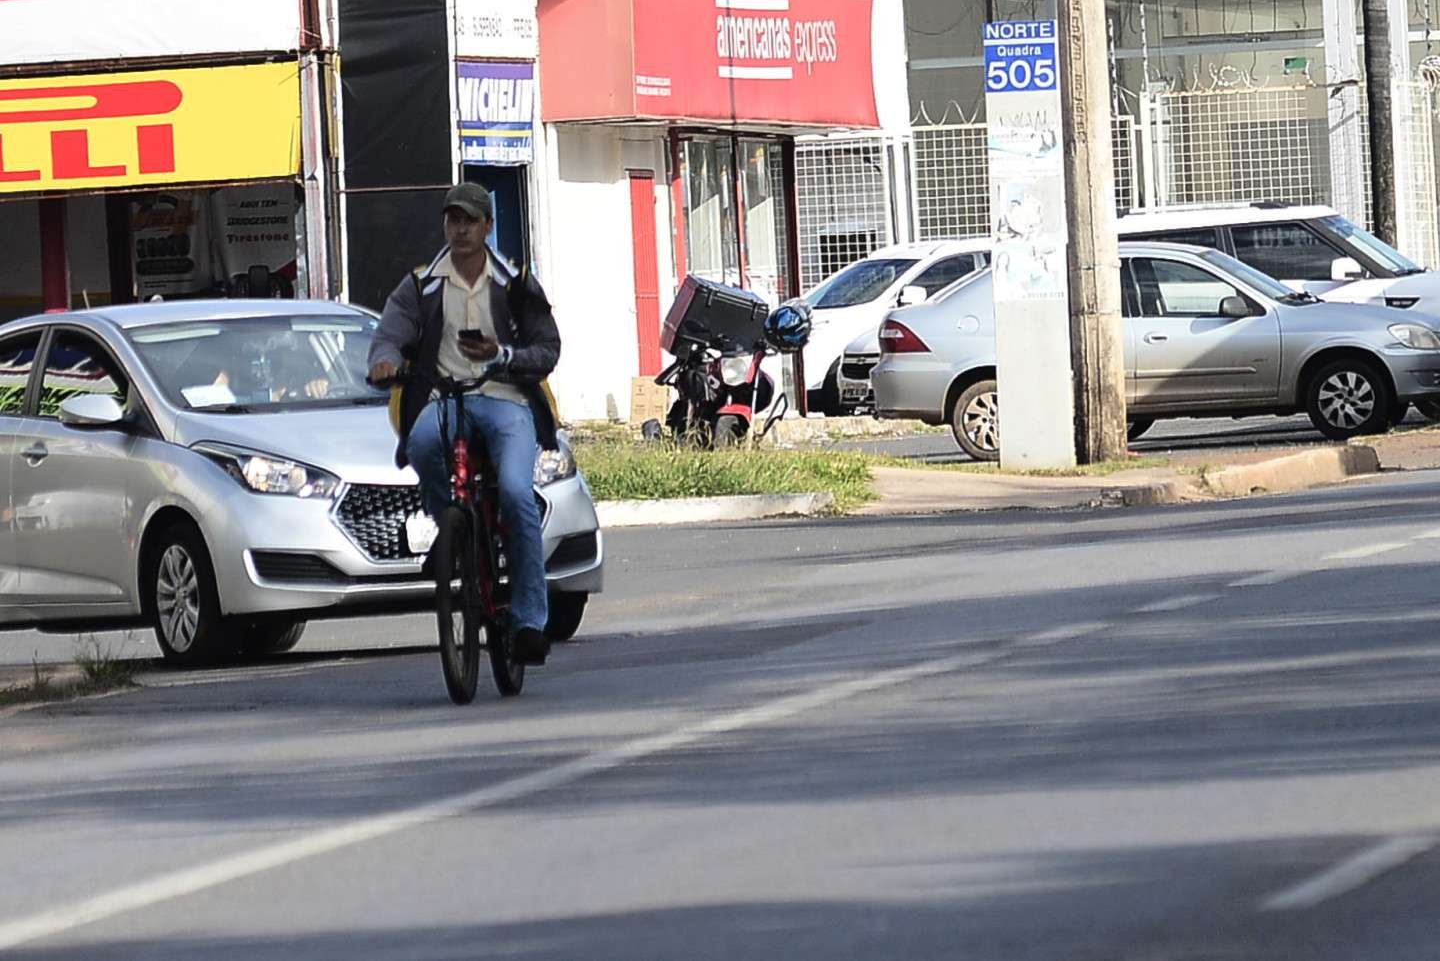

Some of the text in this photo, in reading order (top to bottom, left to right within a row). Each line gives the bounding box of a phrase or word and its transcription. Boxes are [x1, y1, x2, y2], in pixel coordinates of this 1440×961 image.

[986, 22, 1051, 39] NORTE
[716, 15, 837, 76] americanas express
[997, 46, 1042, 58] Quadra
[987, 59, 1055, 90] 505
